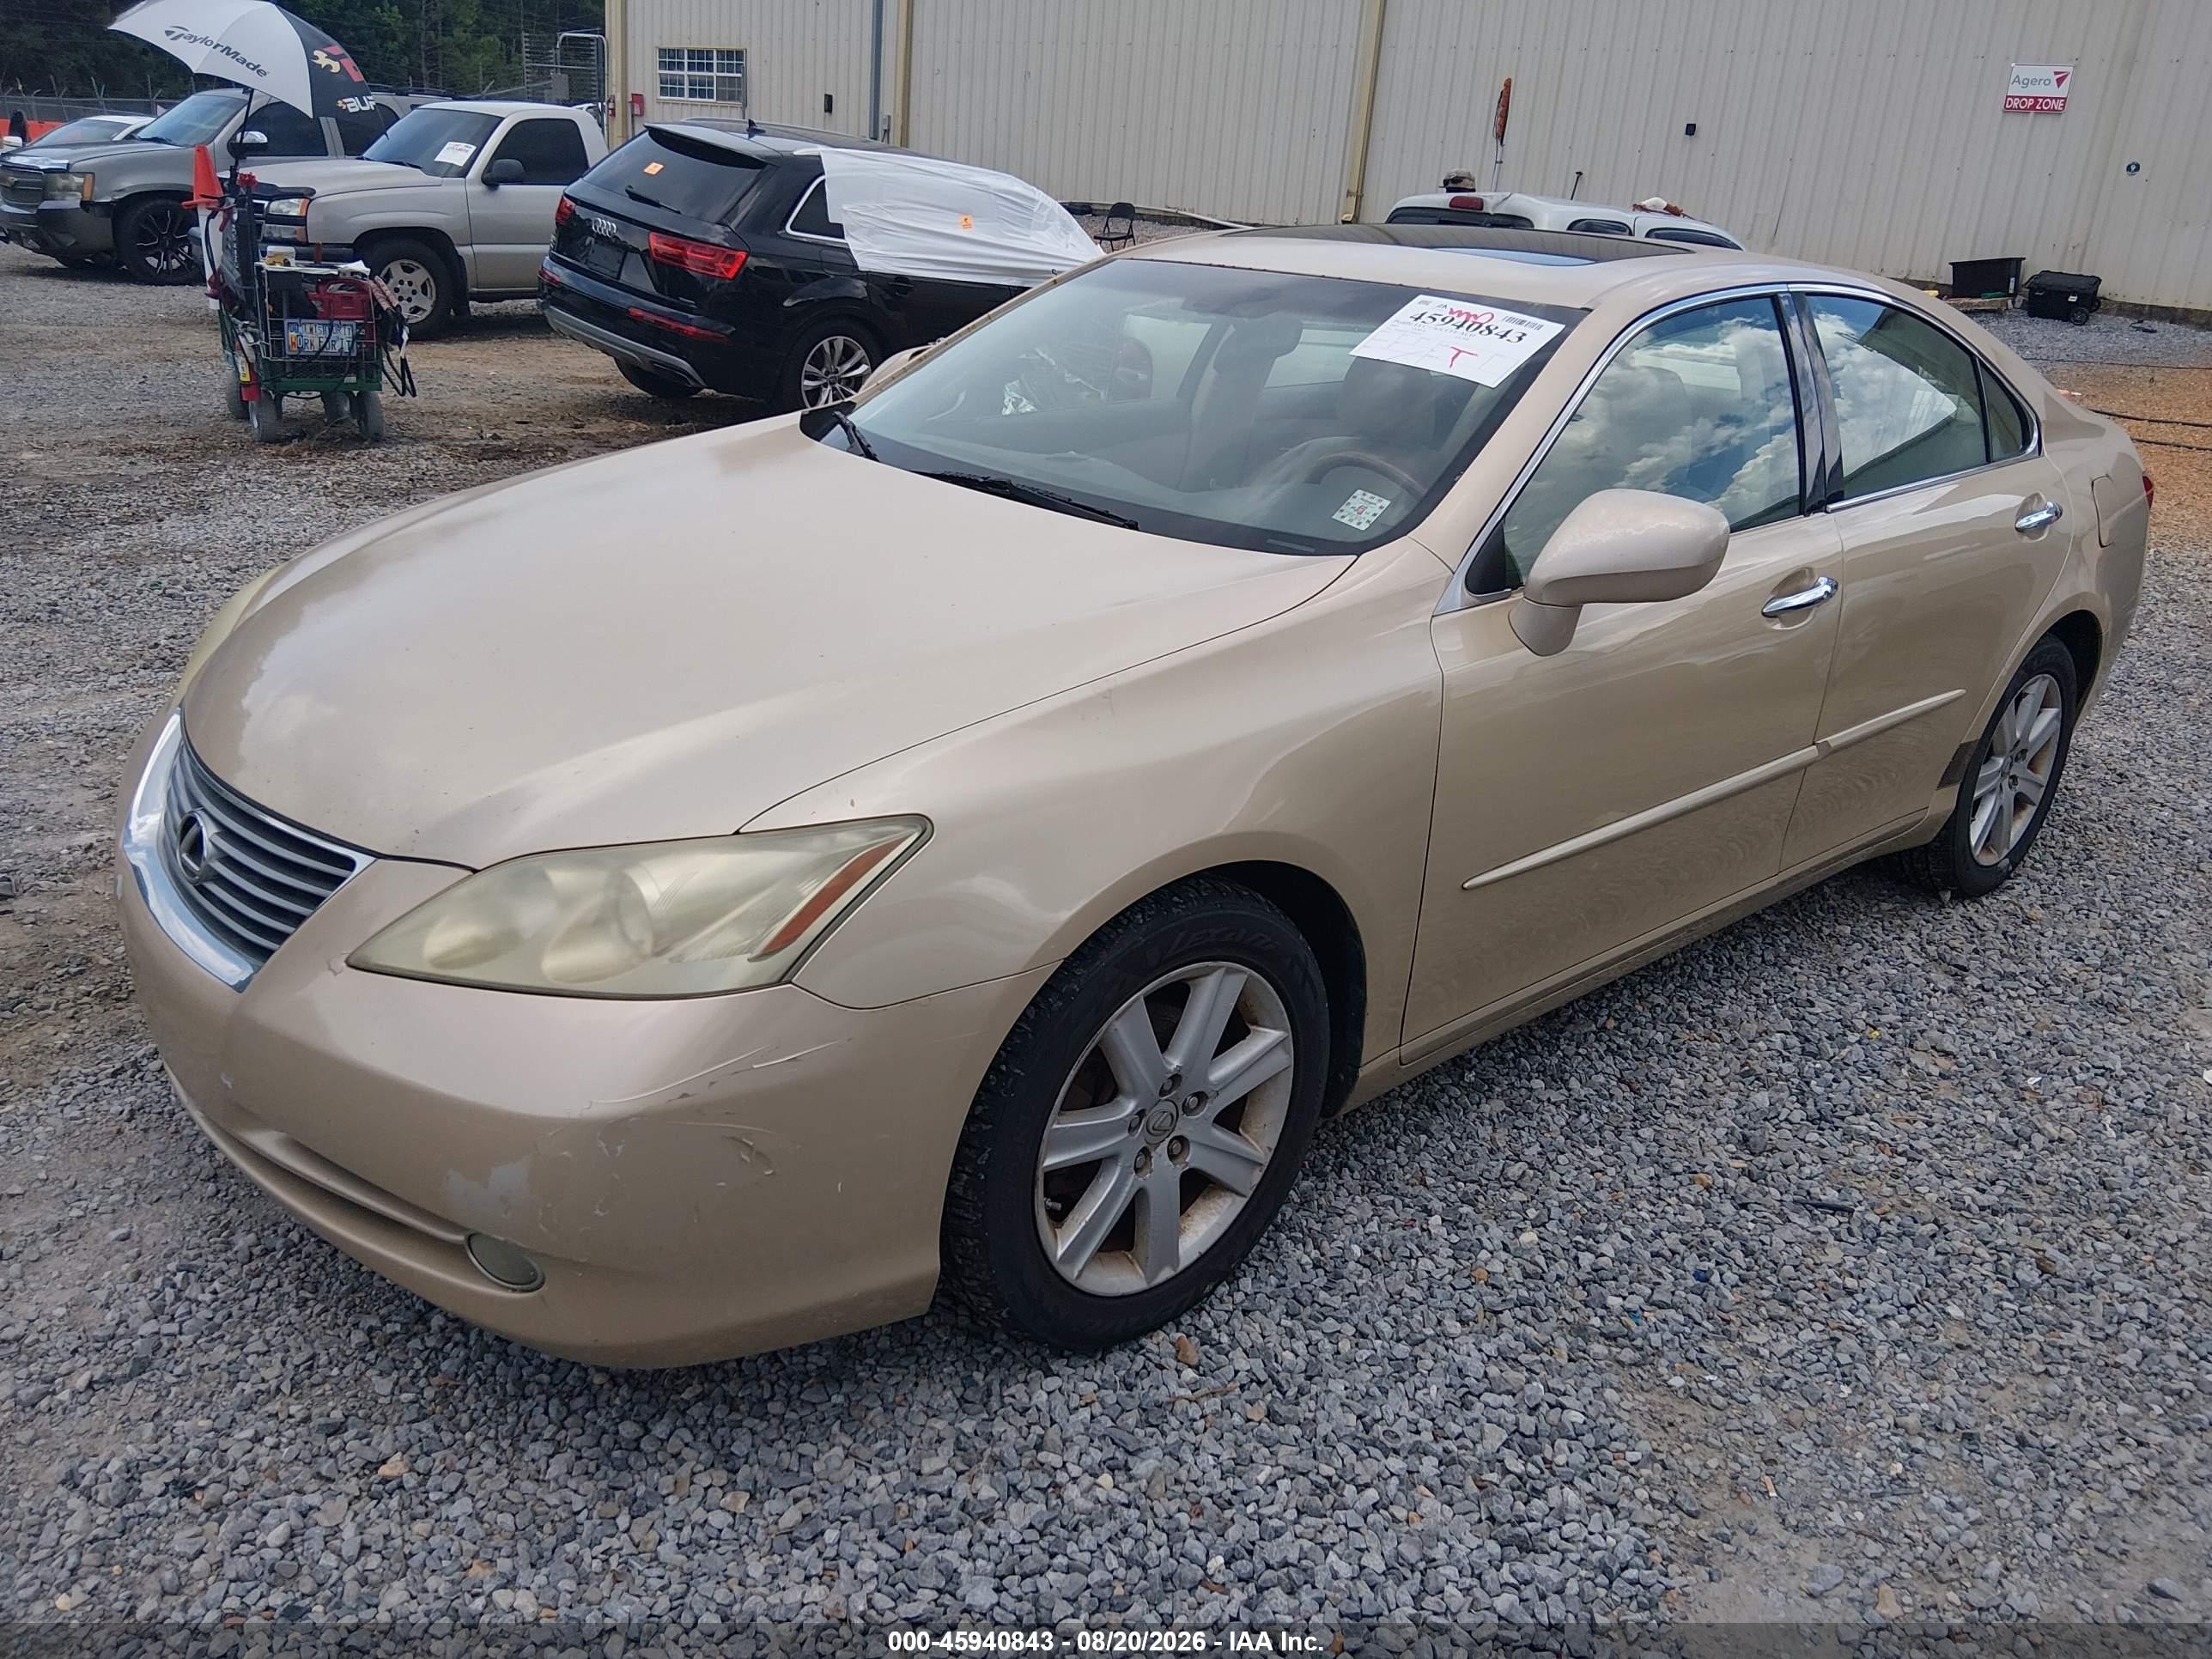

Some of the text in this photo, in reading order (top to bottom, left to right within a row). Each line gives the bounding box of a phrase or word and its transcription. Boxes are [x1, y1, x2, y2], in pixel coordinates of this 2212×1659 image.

[165, 26, 268, 77] TaylorMade
[2011, 75, 2051, 88] Agero
[2005, 97, 2064, 111] DROP ZONE
[1409, 311, 1528, 343] 45940843
[289, 334, 315, 351] WORK
